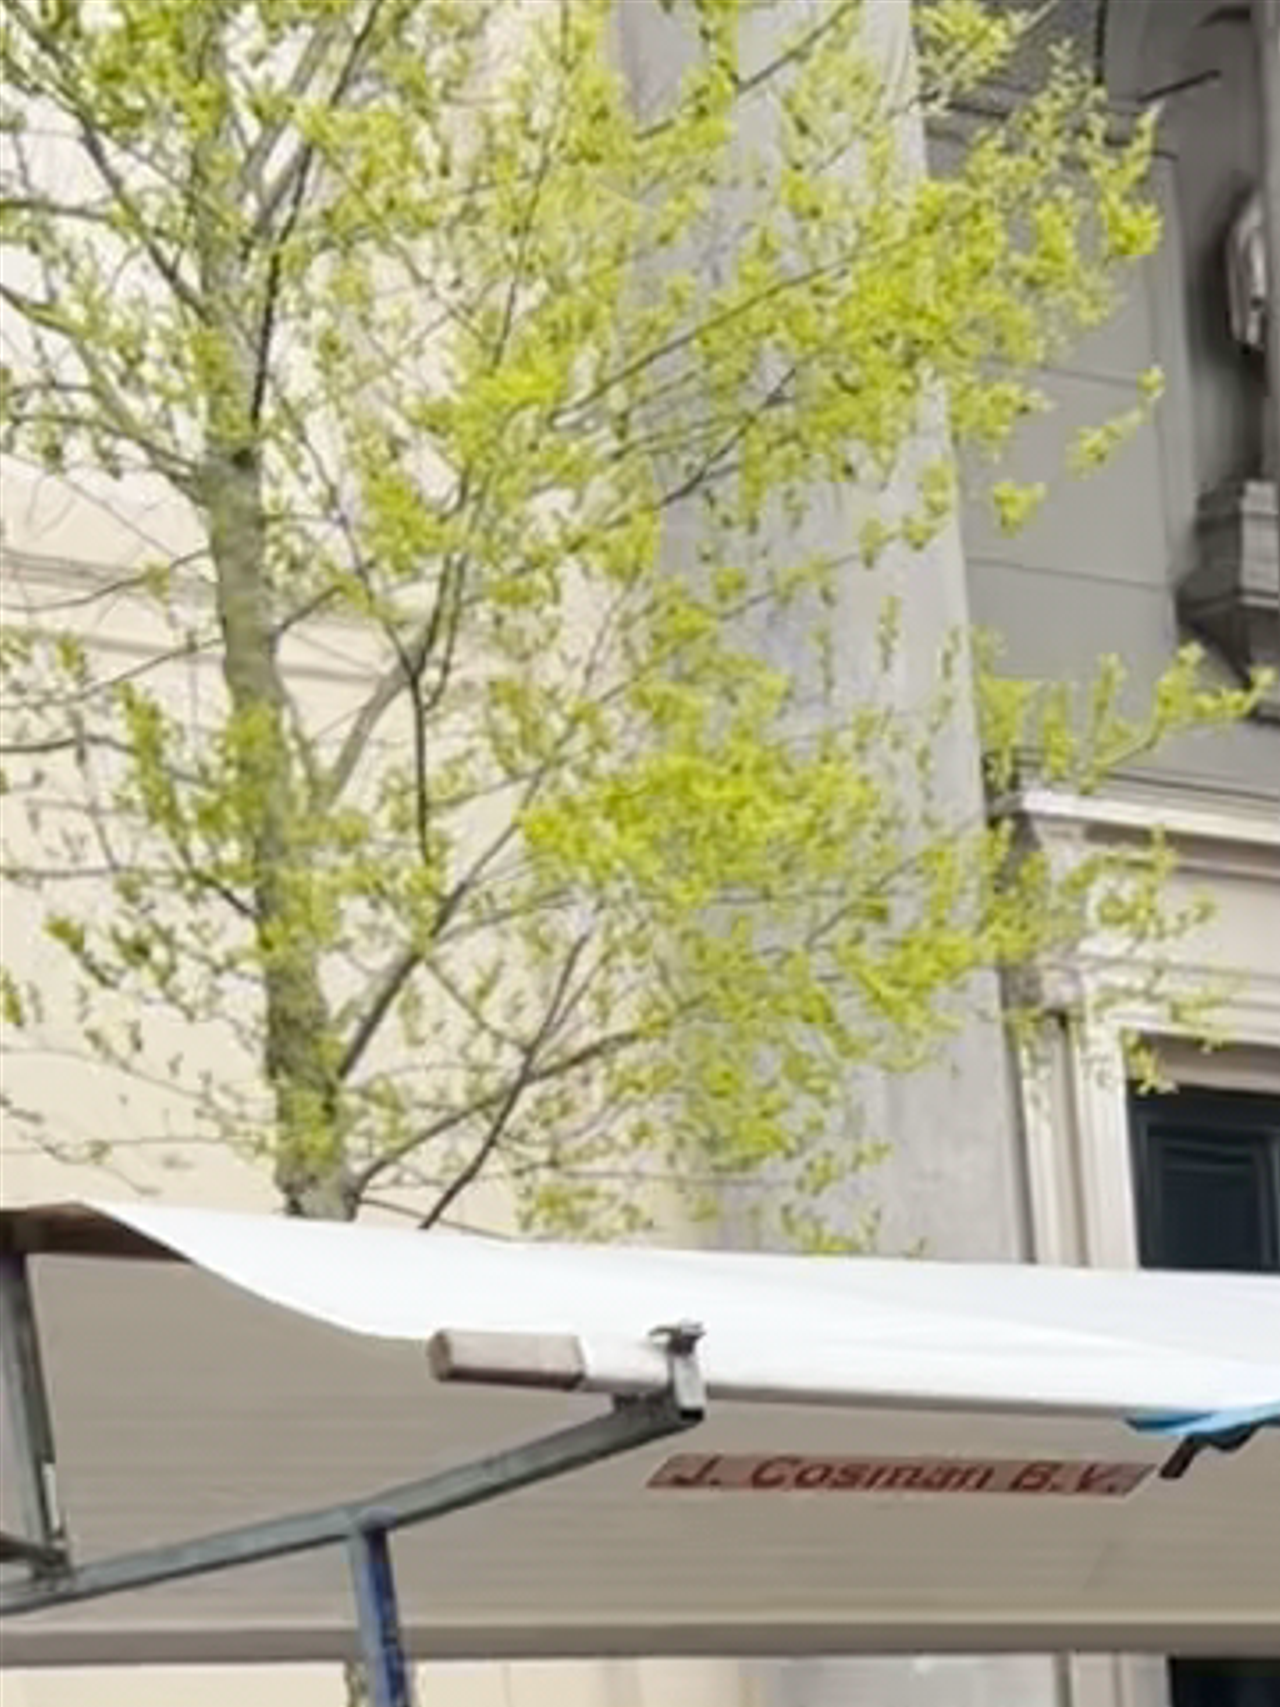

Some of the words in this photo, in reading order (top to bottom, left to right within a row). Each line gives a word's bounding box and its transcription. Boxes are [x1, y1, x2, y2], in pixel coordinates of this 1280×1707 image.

[672, 1455, 723, 1487] J.
[752, 1456, 996, 1490] Cosman
[1008, 1459, 1120, 1494] B.V.
